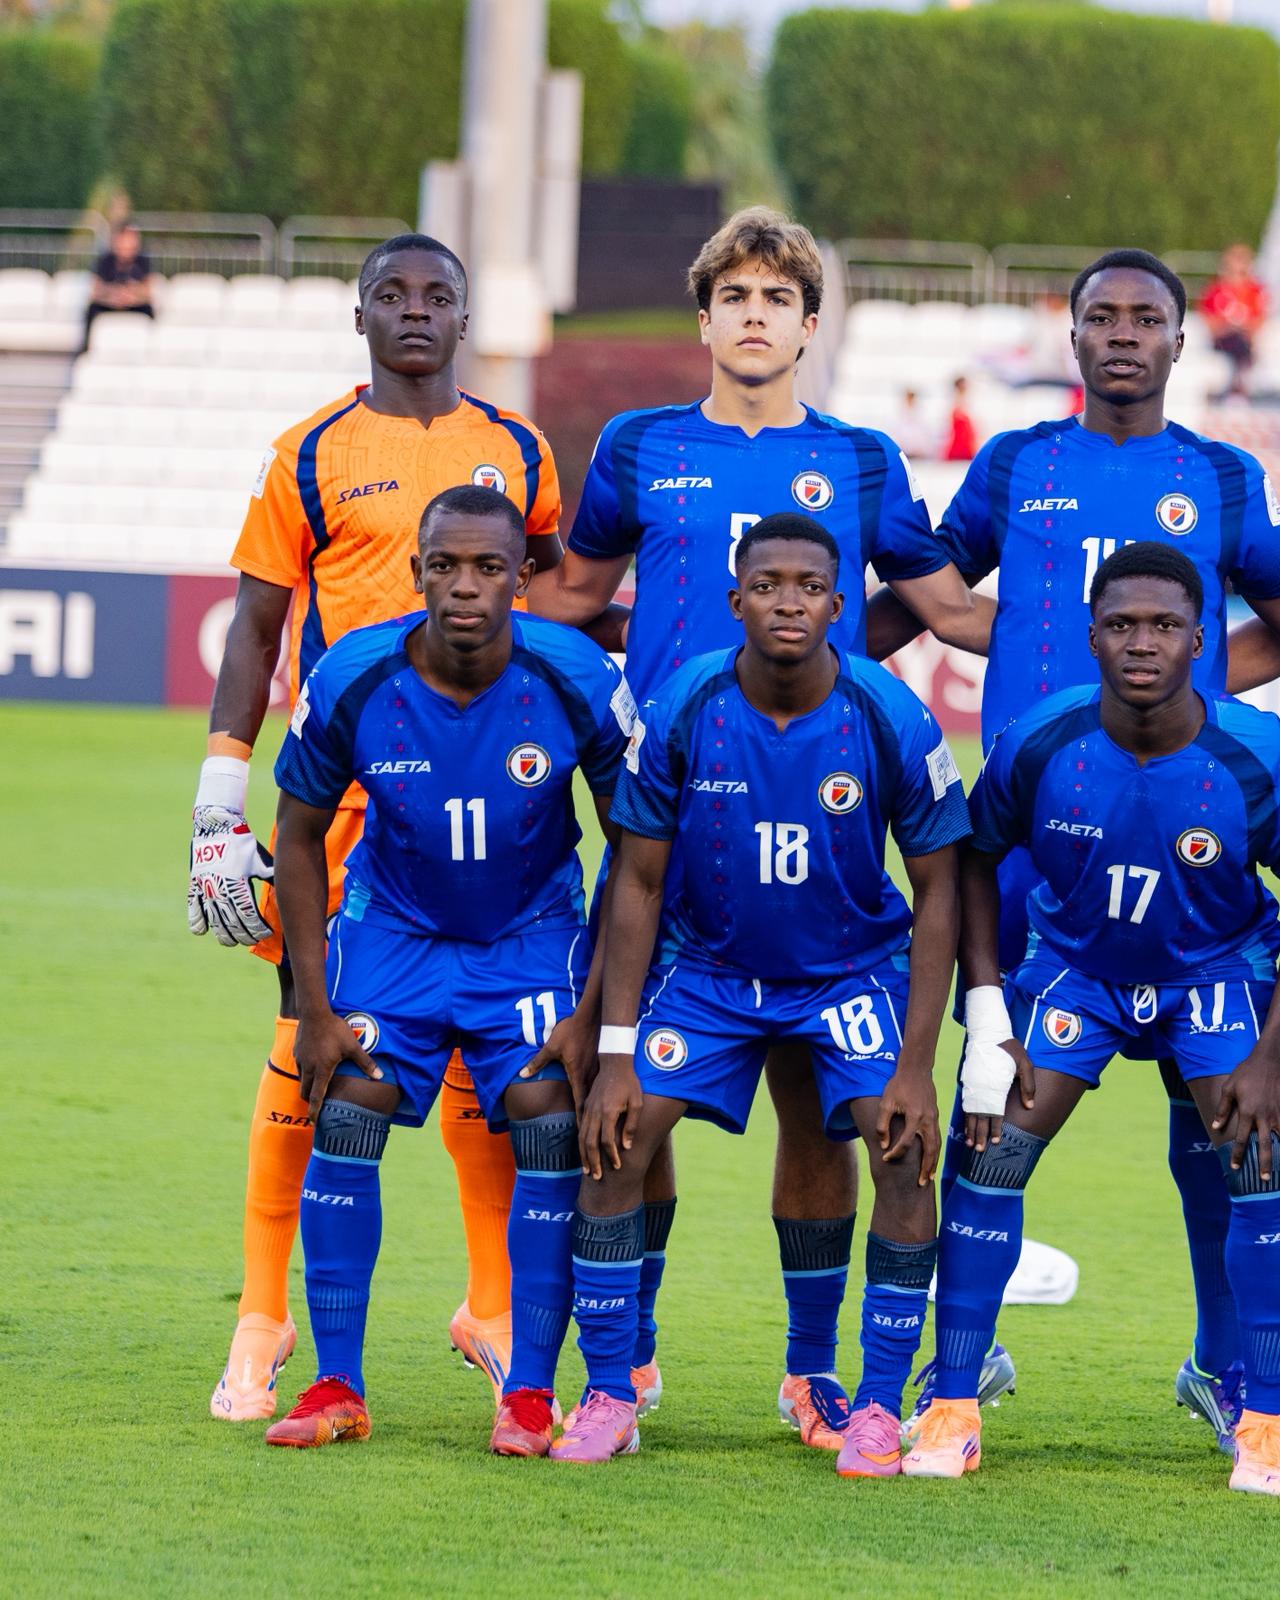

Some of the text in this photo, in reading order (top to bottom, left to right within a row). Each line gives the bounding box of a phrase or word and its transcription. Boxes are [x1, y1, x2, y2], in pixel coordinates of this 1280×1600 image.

[336, 479, 400, 505] SAETA
[648, 477, 713, 491] SAETA
[1018, 498, 1078, 512] SAETA
[364, 760, 431, 775] SAETA
[688, 778, 748, 794] SAETA
[444, 798, 487, 861] 11
[1045, 819, 1103, 840] SAETA
[194, 842, 226, 864] AGK
[754, 821, 810, 885] 18
[1106, 864, 1161, 924] 17
[515, 991, 557, 1047] 11
[820, 995, 884, 1054] 18
[302, 1189, 354, 1206] SAETA
[946, 1222, 1008, 1242] SAETA
[577, 1297, 625, 1310] SAETA
[872, 1313, 919, 1329] SAETA
